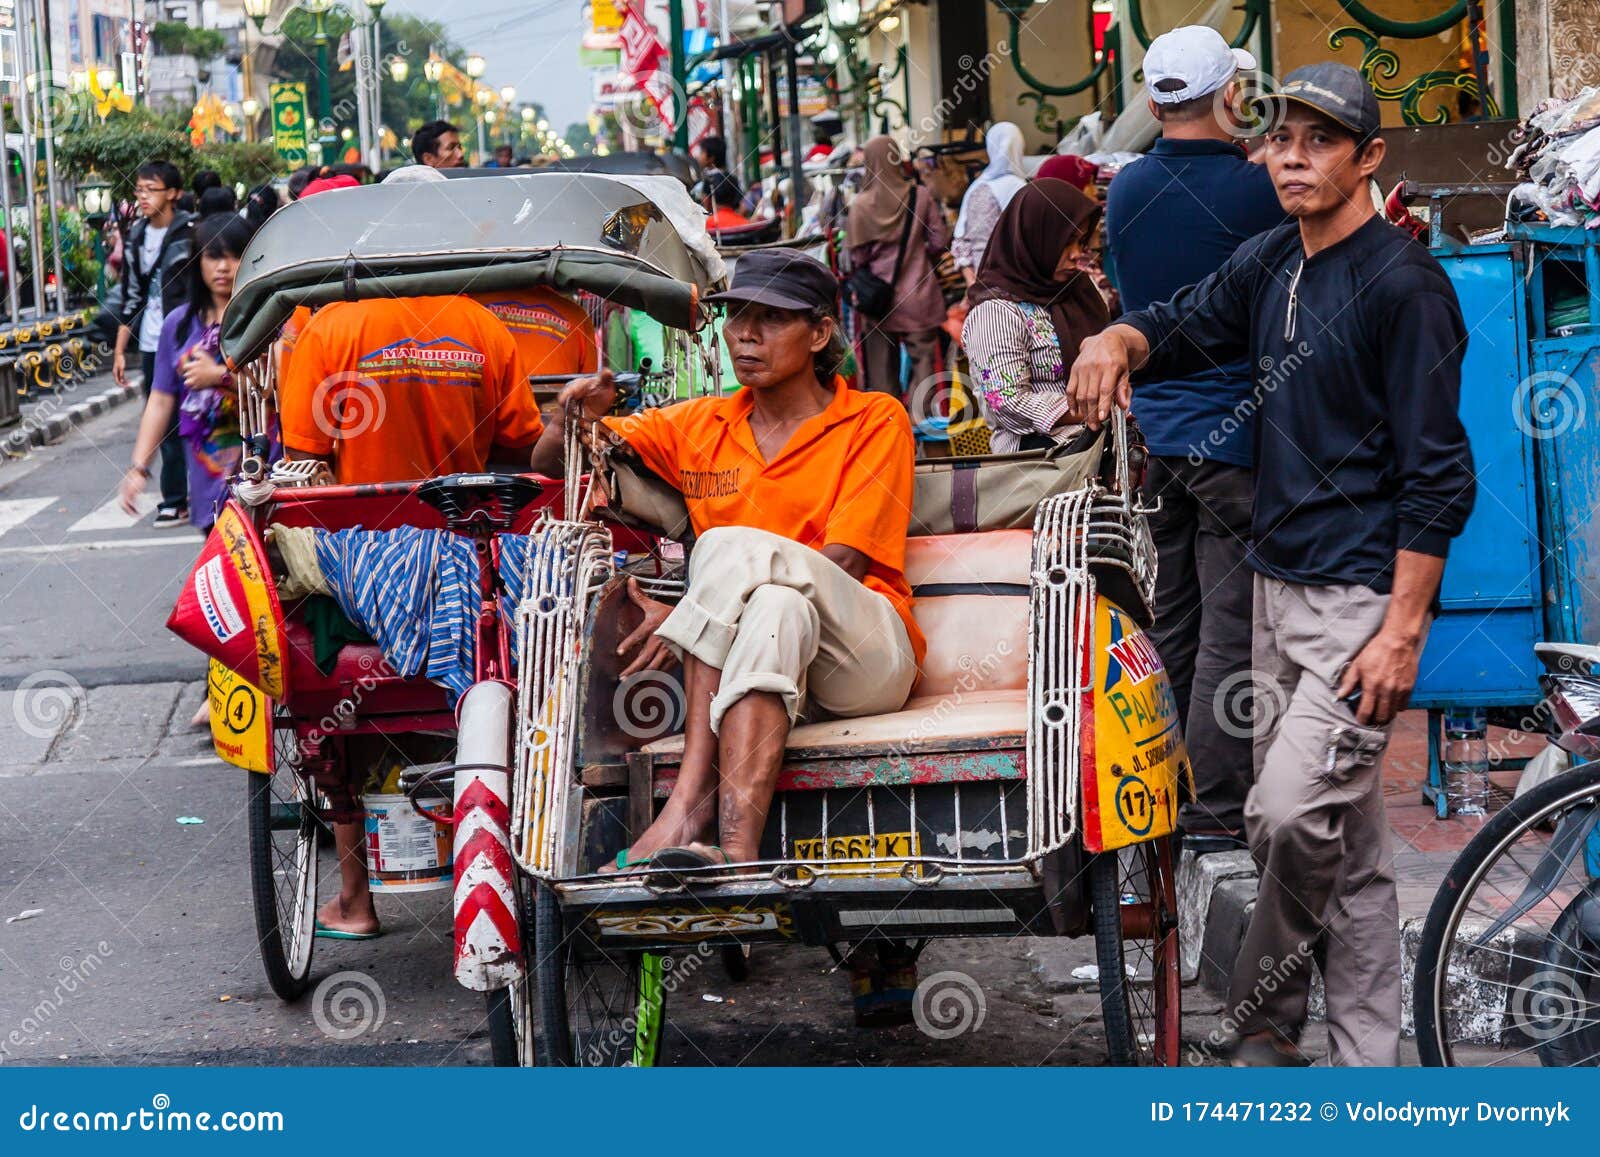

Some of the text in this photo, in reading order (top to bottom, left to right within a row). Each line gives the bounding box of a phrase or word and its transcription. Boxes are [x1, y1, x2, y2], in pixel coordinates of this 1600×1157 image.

[382, 348, 486, 364] MALIOBORO
[233, 701, 243, 720] 4
[1122, 790, 1145, 817] 17
